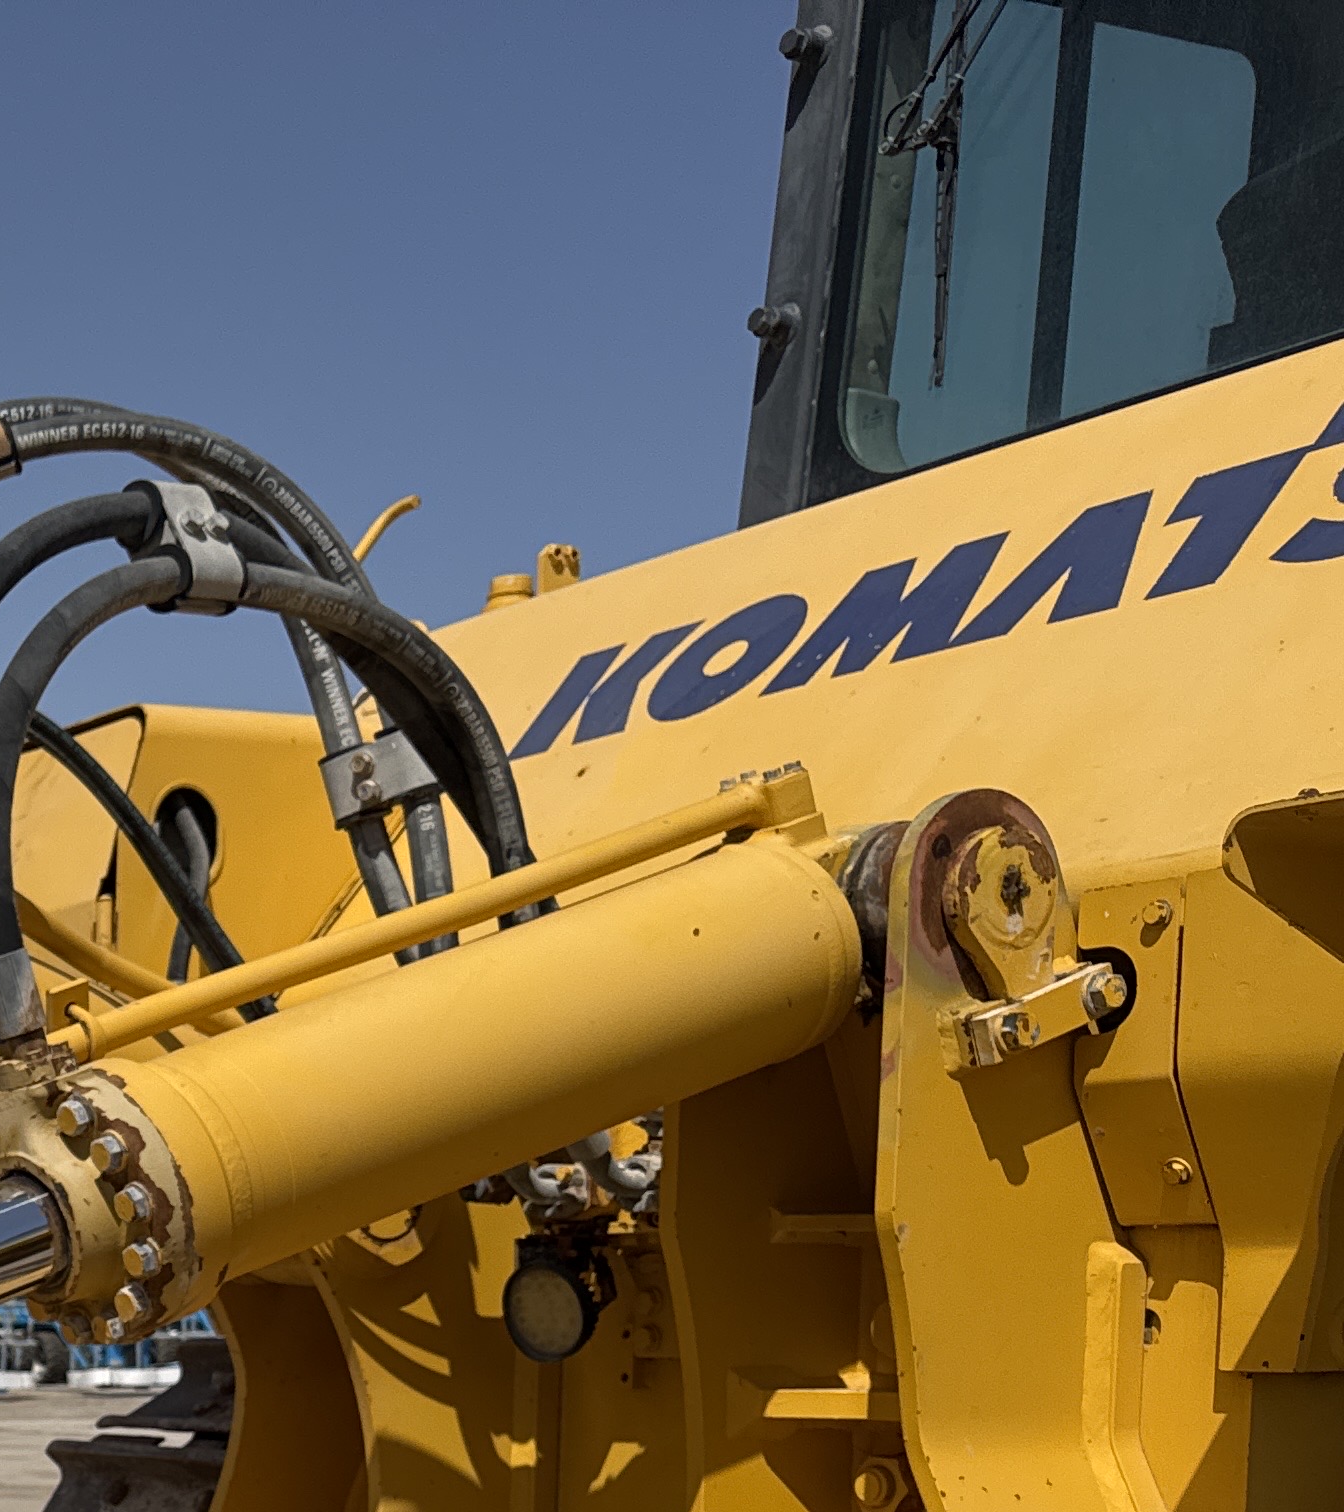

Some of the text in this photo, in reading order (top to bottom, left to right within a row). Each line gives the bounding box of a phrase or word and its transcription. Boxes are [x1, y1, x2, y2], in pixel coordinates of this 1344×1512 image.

[17, 424, 79, 449] WINNER
[82, 423, 146, 440] EC512-16
[321, 667, 349, 726] WINNER
